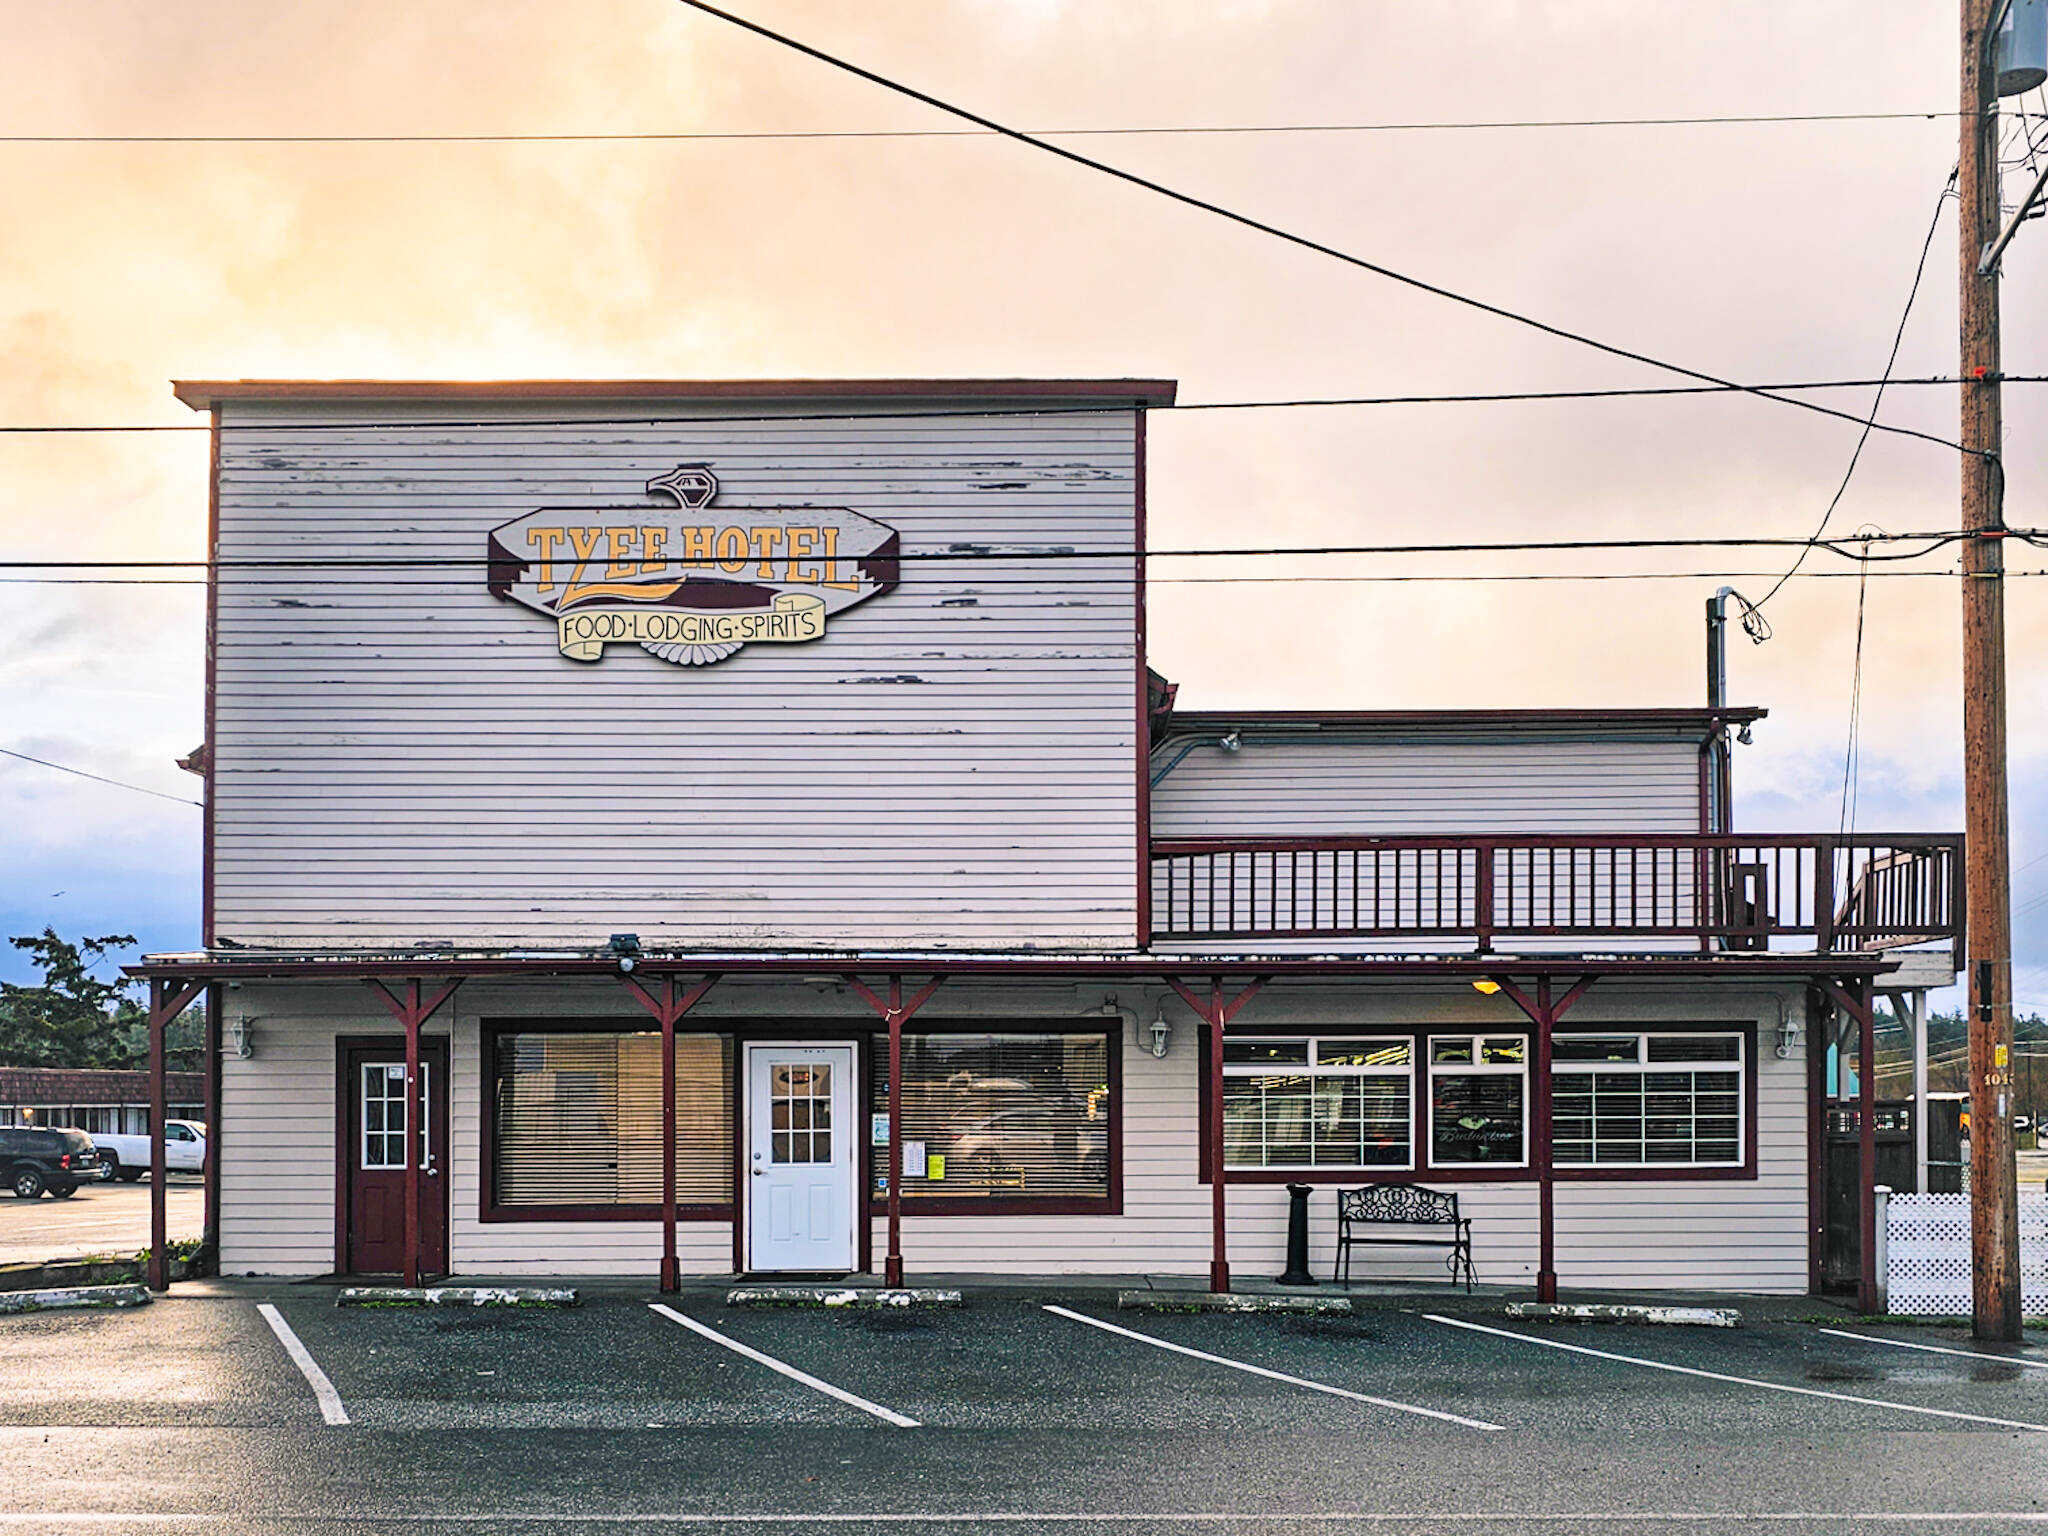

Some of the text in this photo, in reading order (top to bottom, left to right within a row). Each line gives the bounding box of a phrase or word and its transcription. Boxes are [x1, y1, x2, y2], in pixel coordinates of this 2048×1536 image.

[527, 525, 860, 609] TYEE HOTEL
[740, 611, 817, 638] SPIRITS
